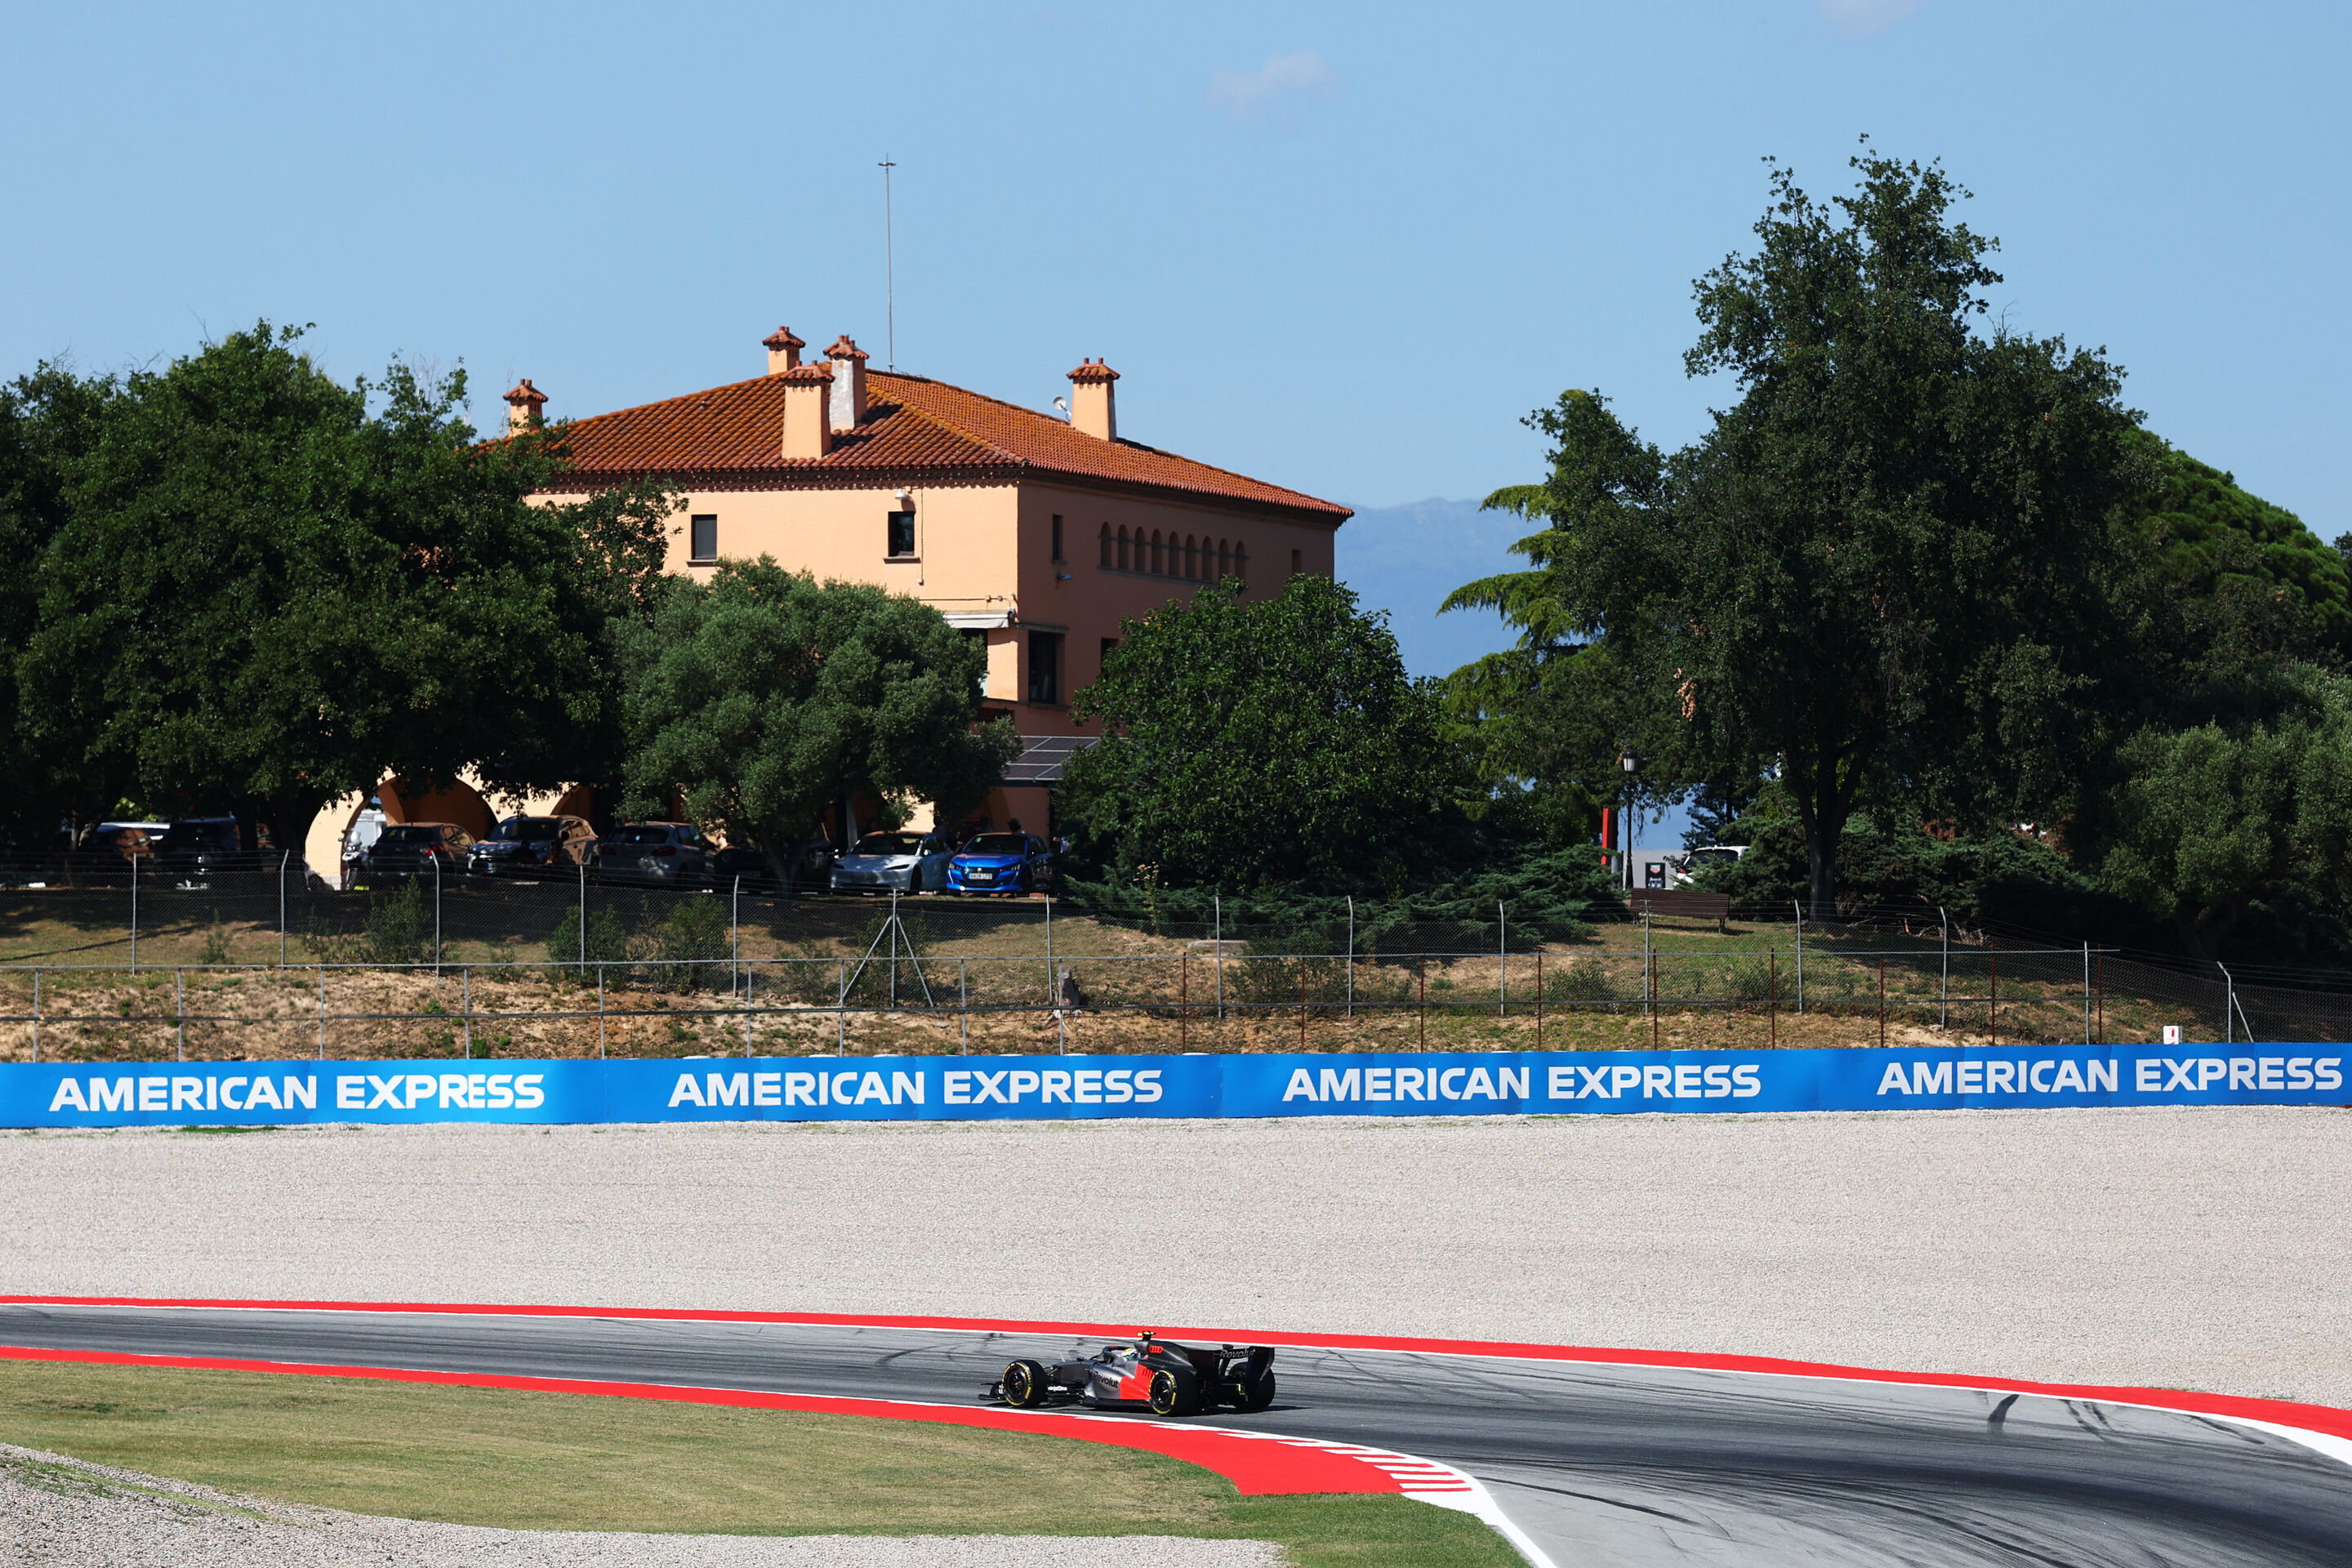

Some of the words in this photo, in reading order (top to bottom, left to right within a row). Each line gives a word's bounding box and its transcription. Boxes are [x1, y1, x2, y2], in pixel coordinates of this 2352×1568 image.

[49, 1076, 316, 1111] AMERICAN
[337, 1075, 544, 1109] EXPRESS
[668, 1071, 924, 1107] AMERICAN
[944, 1071, 1163, 1103] EXPRESS
[1282, 1067, 1529, 1101] AMERICAN
[1549, 1065, 1761, 1098] EXPRESS
[1878, 1060, 2118, 1094] AMERICAN
[2136, 1058, 2342, 1091] EXPRESS
[1220, 1348, 1256, 1358] Revolut
[1094, 1371, 1120, 1388] Revolut
